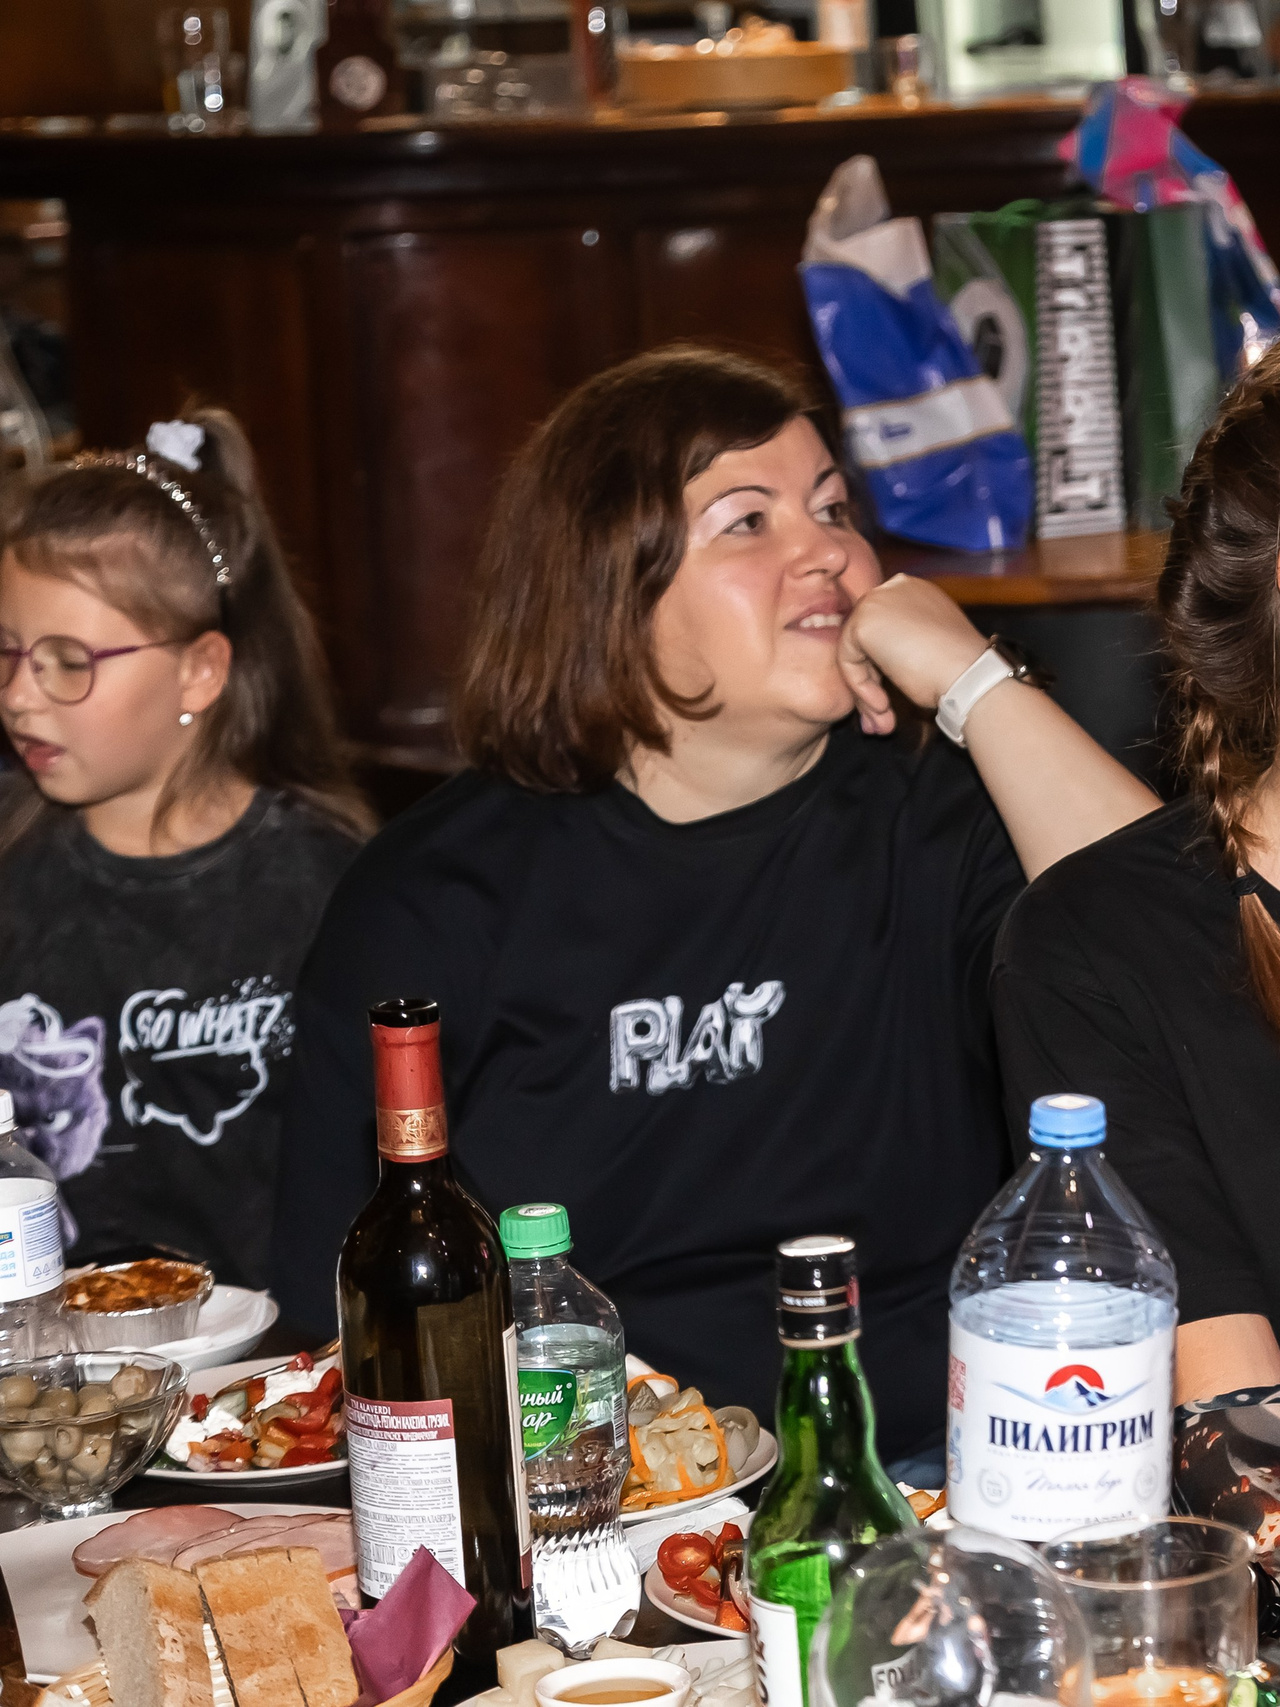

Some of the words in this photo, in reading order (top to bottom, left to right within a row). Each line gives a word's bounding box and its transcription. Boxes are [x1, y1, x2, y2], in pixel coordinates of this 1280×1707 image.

[136, 1007, 176, 1050] SO
[360, 1403, 391, 1415] ALAVERDI
[522, 1411, 557, 1434] ар
[988, 1410, 1154, 1453] ПИЛИГРИМ
